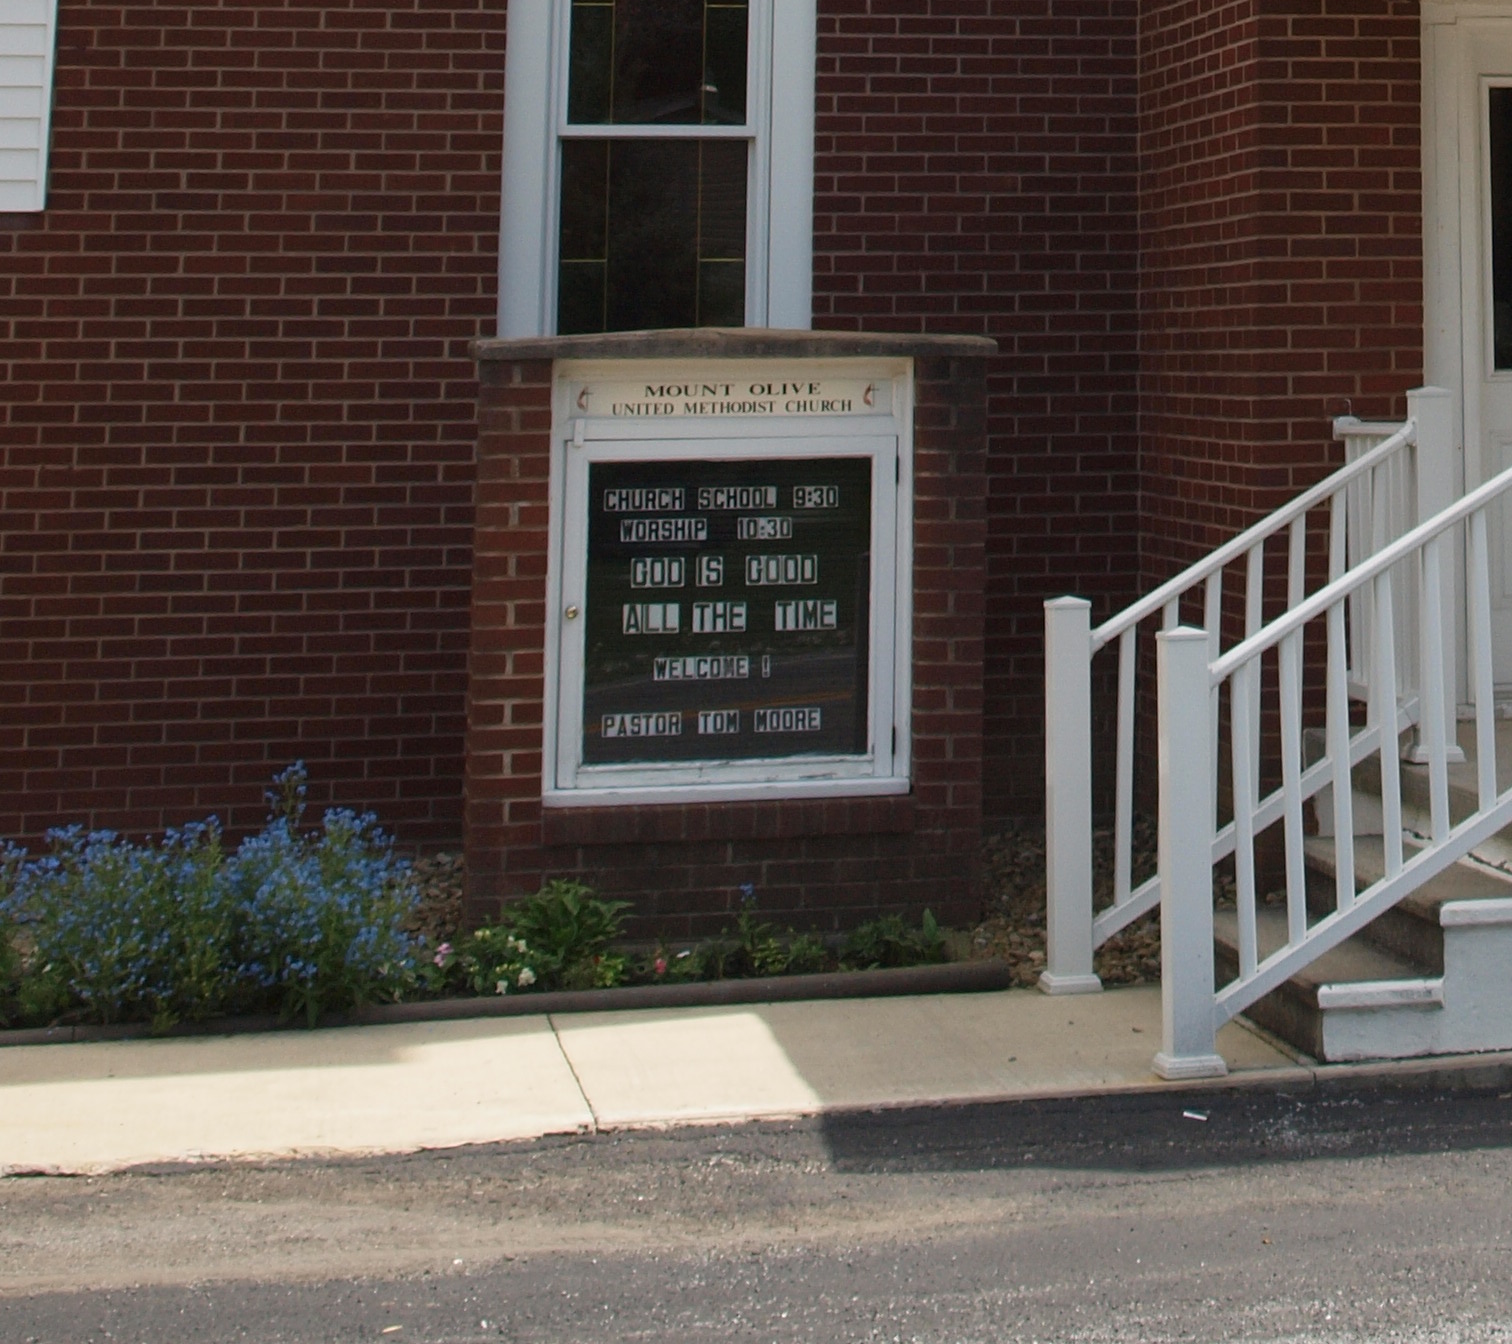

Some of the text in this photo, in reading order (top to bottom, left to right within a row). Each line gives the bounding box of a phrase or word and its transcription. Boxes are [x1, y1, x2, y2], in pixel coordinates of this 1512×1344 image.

[645, 382, 821, 397] MOUNT OLIVE
[612, 399, 852, 416] UNITED METHODIST CHURCH
[605, 486, 838, 510] CHURCH SCHOOL 9:30
[621, 517, 792, 541] WORSHIP 10:30
[631, 555, 817, 587] GOD IS GOOD
[624, 600, 837, 633] ALL THE TIME
[654, 656, 749, 680] WELCOME
[602, 708, 820, 737] PASTOR TOM MOORE
